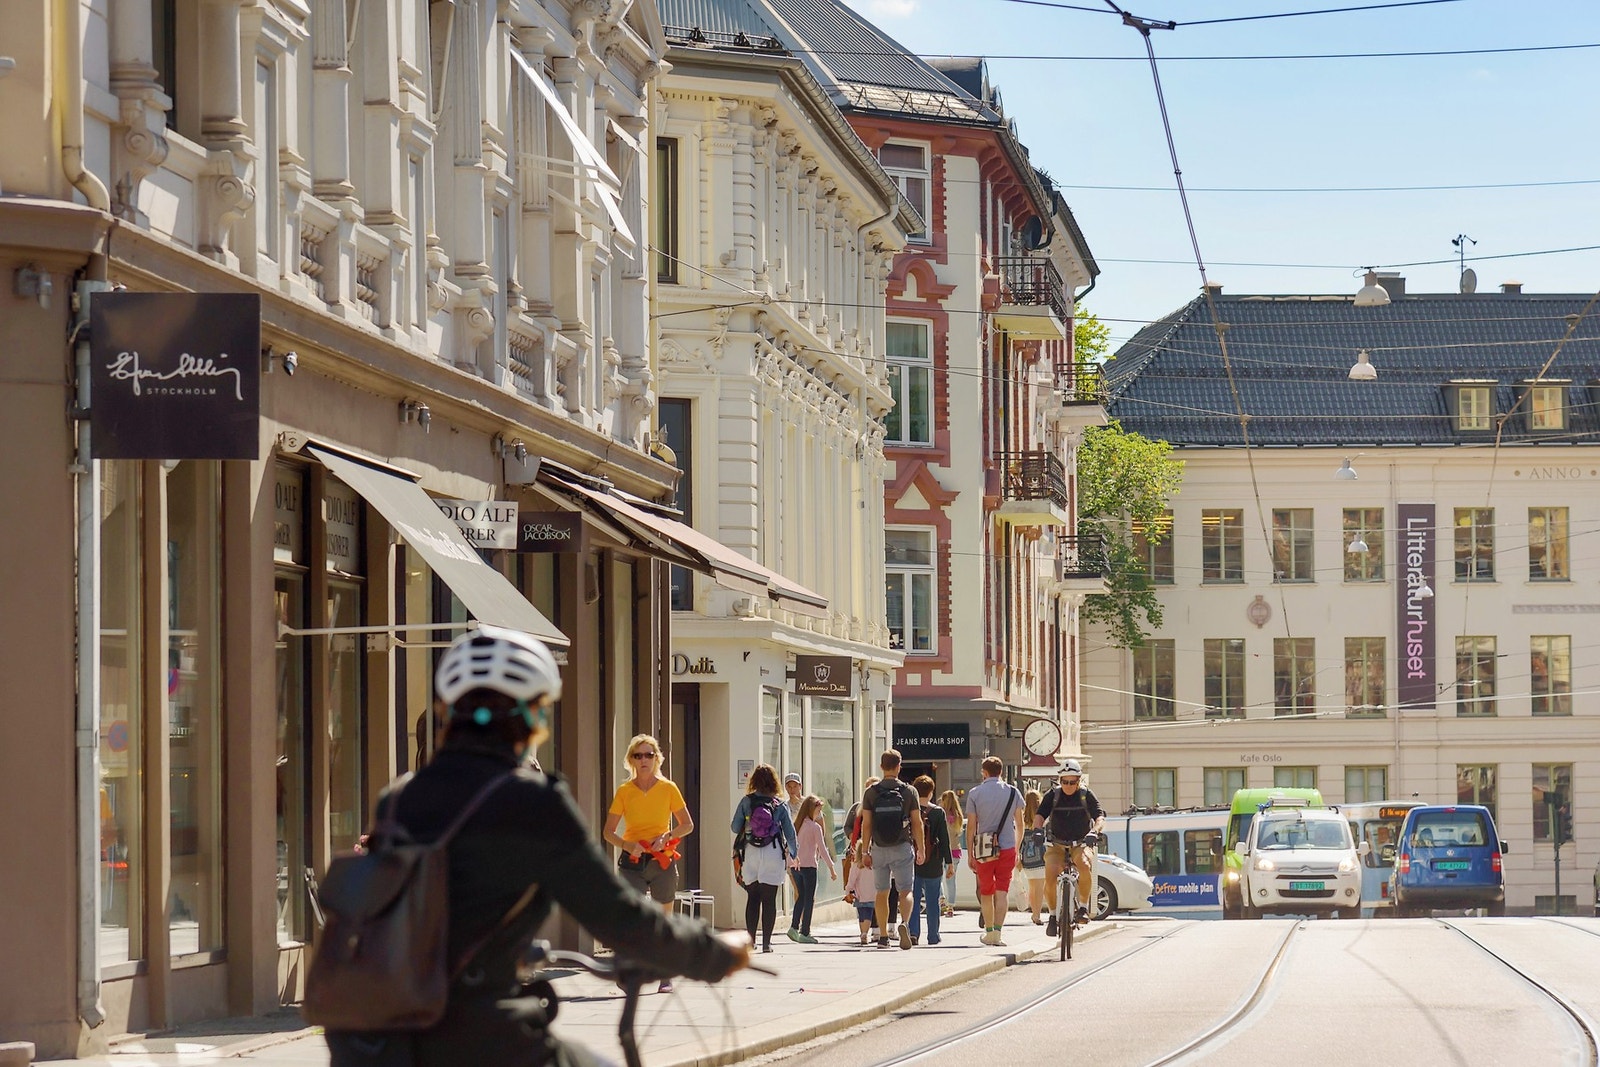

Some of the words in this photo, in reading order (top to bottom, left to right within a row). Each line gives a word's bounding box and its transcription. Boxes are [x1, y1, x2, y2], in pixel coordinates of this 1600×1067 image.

[1529, 467, 1581, 480] ANNO
[481, 507, 515, 523] ALF
[523, 523, 570, 533] OSCAR
[524, 530, 571, 542] JACOBSON
[672, 653, 717, 676] Dutti
[920, 737, 945, 745] REPAIR
[946, 737, 965, 745] SHOP
[1240, 754, 1260, 762] Kafe
[1262, 754, 1282, 762] Oslo
[1178, 883, 1199, 893] mobile
[1200, 882, 1213, 895] plan
